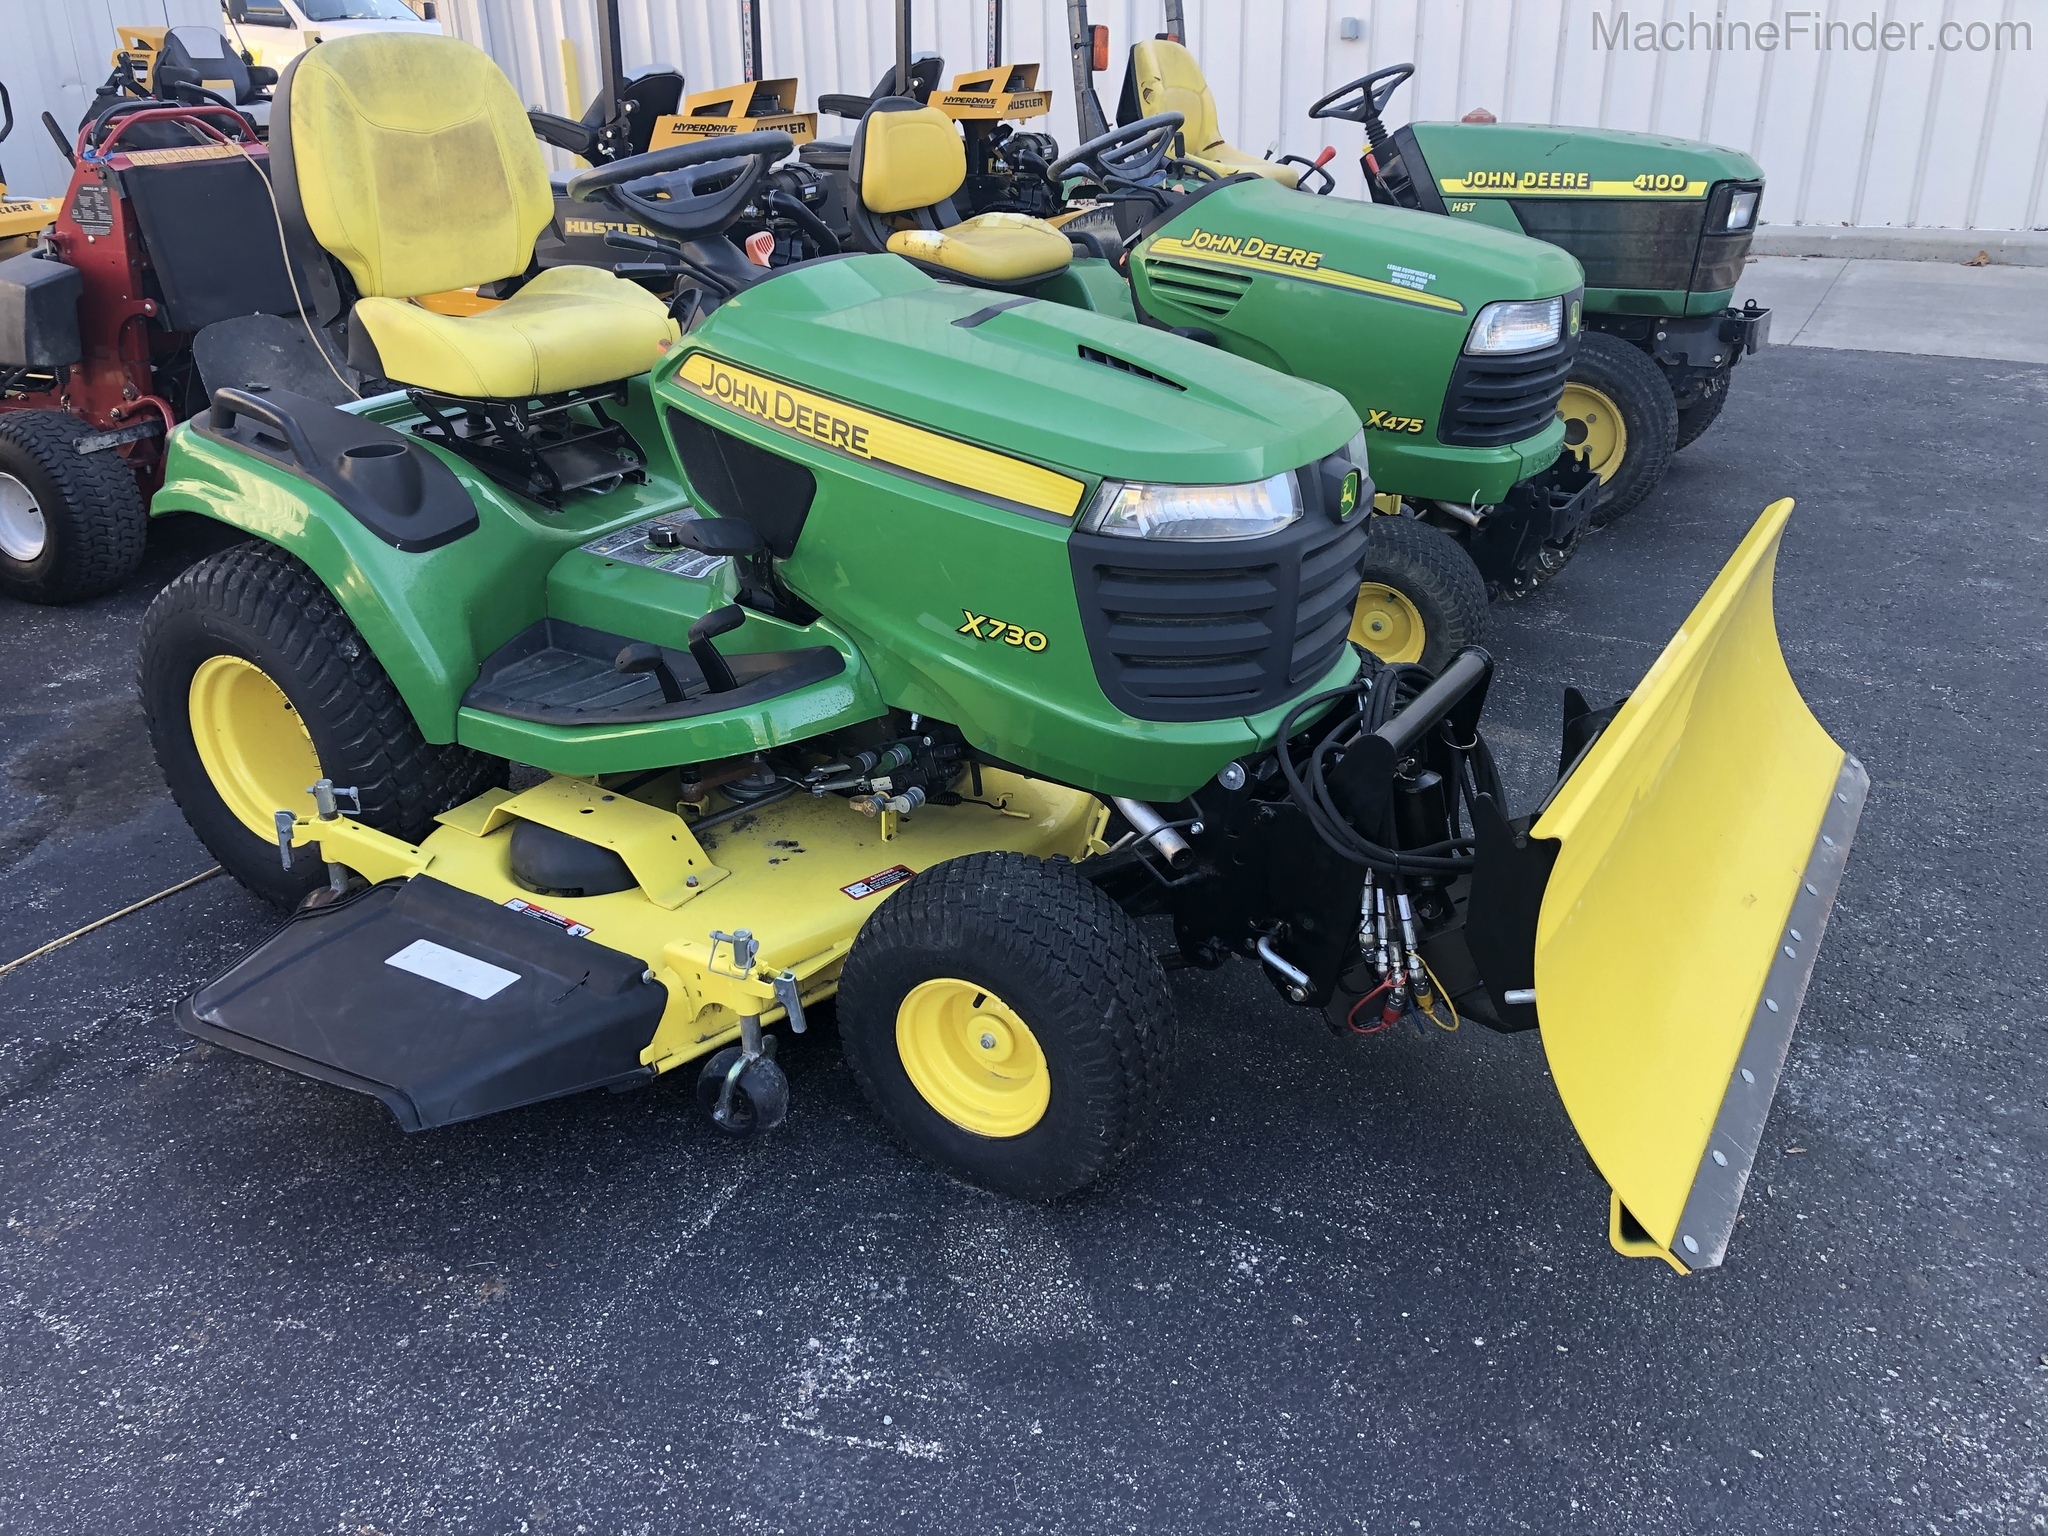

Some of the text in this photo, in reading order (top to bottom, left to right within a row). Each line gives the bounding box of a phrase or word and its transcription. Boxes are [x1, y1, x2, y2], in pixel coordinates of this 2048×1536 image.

[943, 96, 998, 105] HYPERDRIVE
[1007, 97, 1043, 111] HUSTLER
[672, 122, 738, 133] HYPERDRIVE
[1461, 171, 1688, 192] JOHN DEERE 4100
[1451, 202, 1476, 213] HST
[1181, 228, 1323, 270] JOHN DEERE
[701, 363, 869, 454] JOHN DEERE
[1363, 408, 1426, 435] X475
[955, 608, 1050, 654] X730
